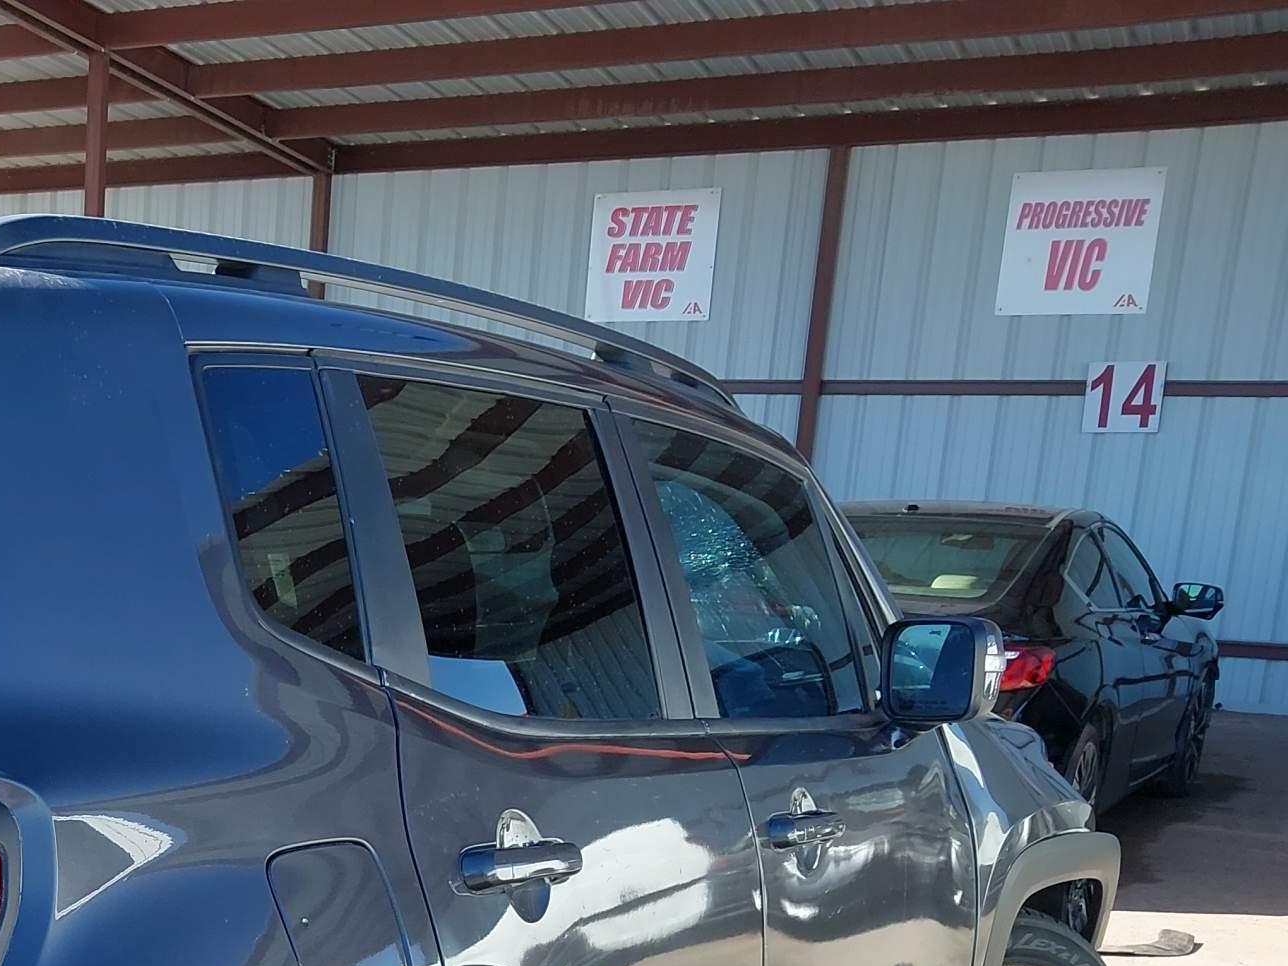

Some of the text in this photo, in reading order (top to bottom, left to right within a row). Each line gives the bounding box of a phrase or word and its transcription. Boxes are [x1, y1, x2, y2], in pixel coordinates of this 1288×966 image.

[607, 204, 699, 238] STATE
[1016, 198, 1151, 230] PROGRESSIVE
[605, 241, 692, 273] FARM
[1044, 238, 1107, 291] VIC
[621, 278, 675, 310] VIC
[1091, 364, 1157, 428] 14
